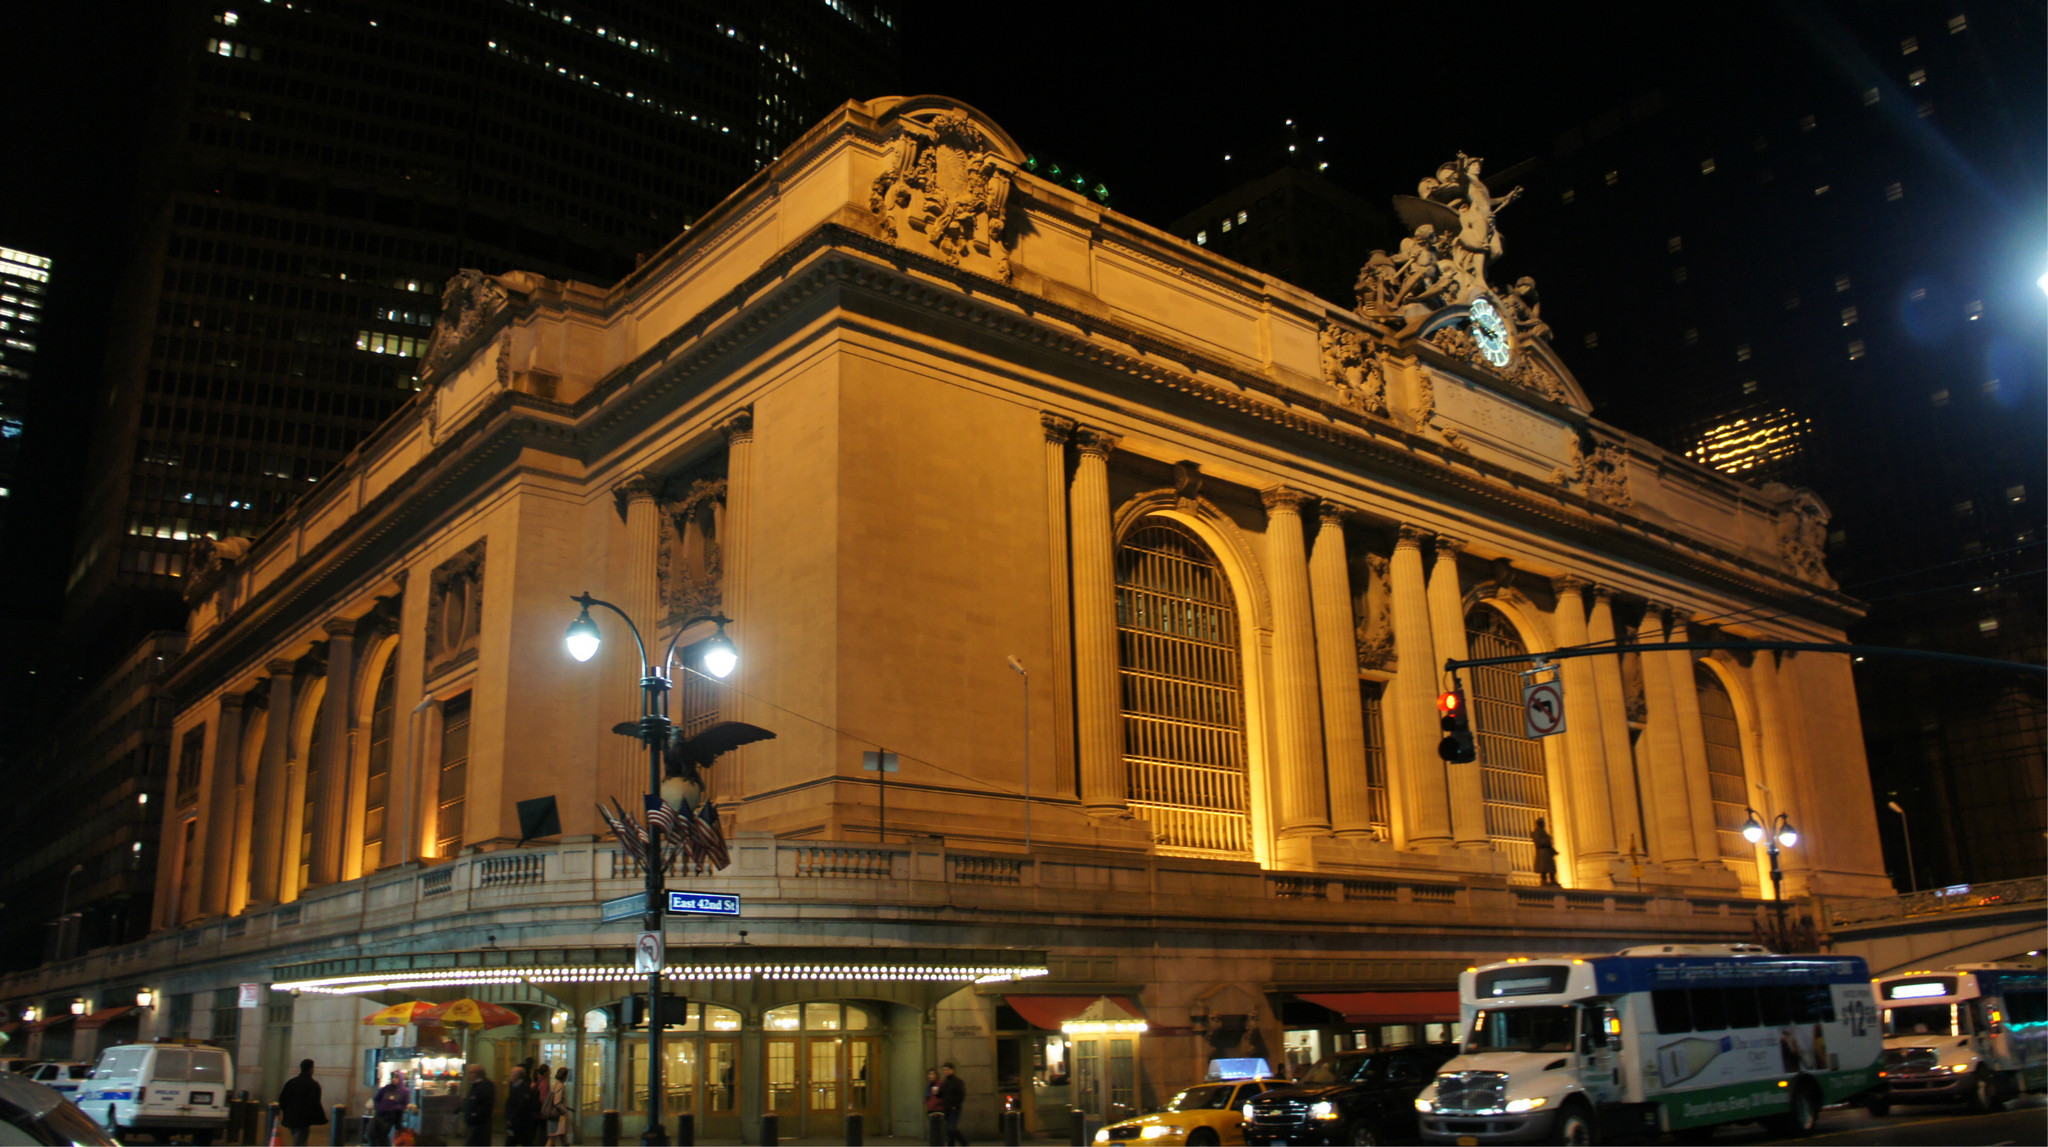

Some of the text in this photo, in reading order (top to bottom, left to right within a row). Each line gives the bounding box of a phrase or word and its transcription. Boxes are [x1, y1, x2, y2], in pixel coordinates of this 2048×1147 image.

[673, 897, 736, 911] East 42nd St
